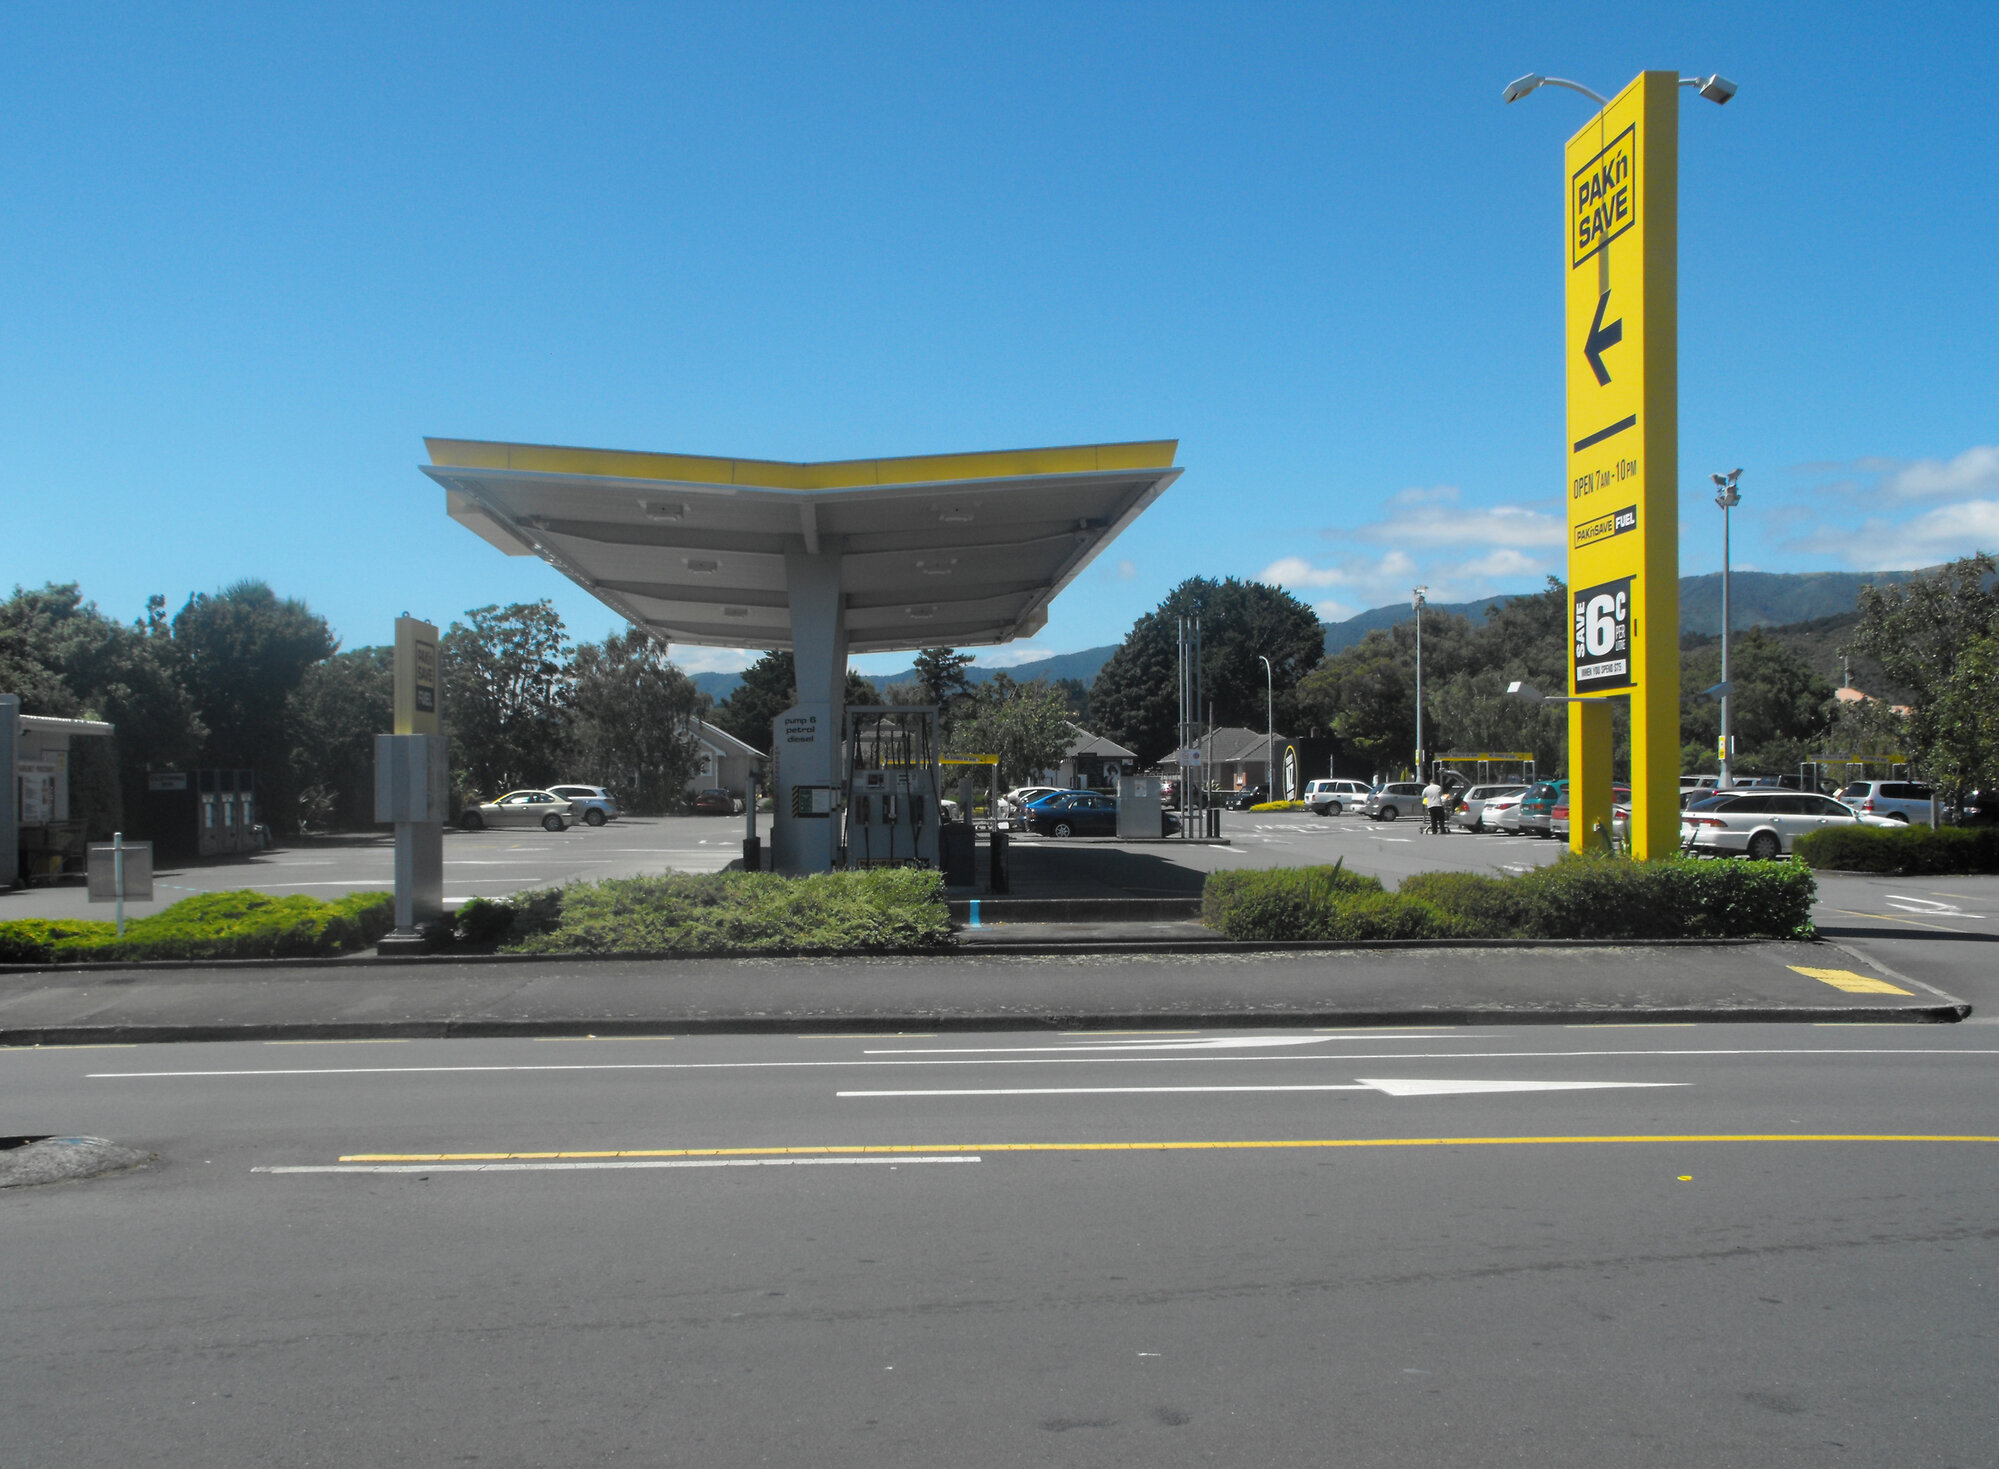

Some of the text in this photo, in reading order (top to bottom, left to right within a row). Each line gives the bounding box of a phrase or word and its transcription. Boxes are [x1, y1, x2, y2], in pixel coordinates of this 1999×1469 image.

[1579, 185, 1628, 249] SAVE
[1574, 473, 1594, 499] OPEN
[1615, 512, 1635, 530] FUEL
[1576, 601, 1585, 658] SAVE
[785, 717, 807, 725] pump
[786, 726, 816, 734] petrol
[787, 735, 814, 743] diesel
